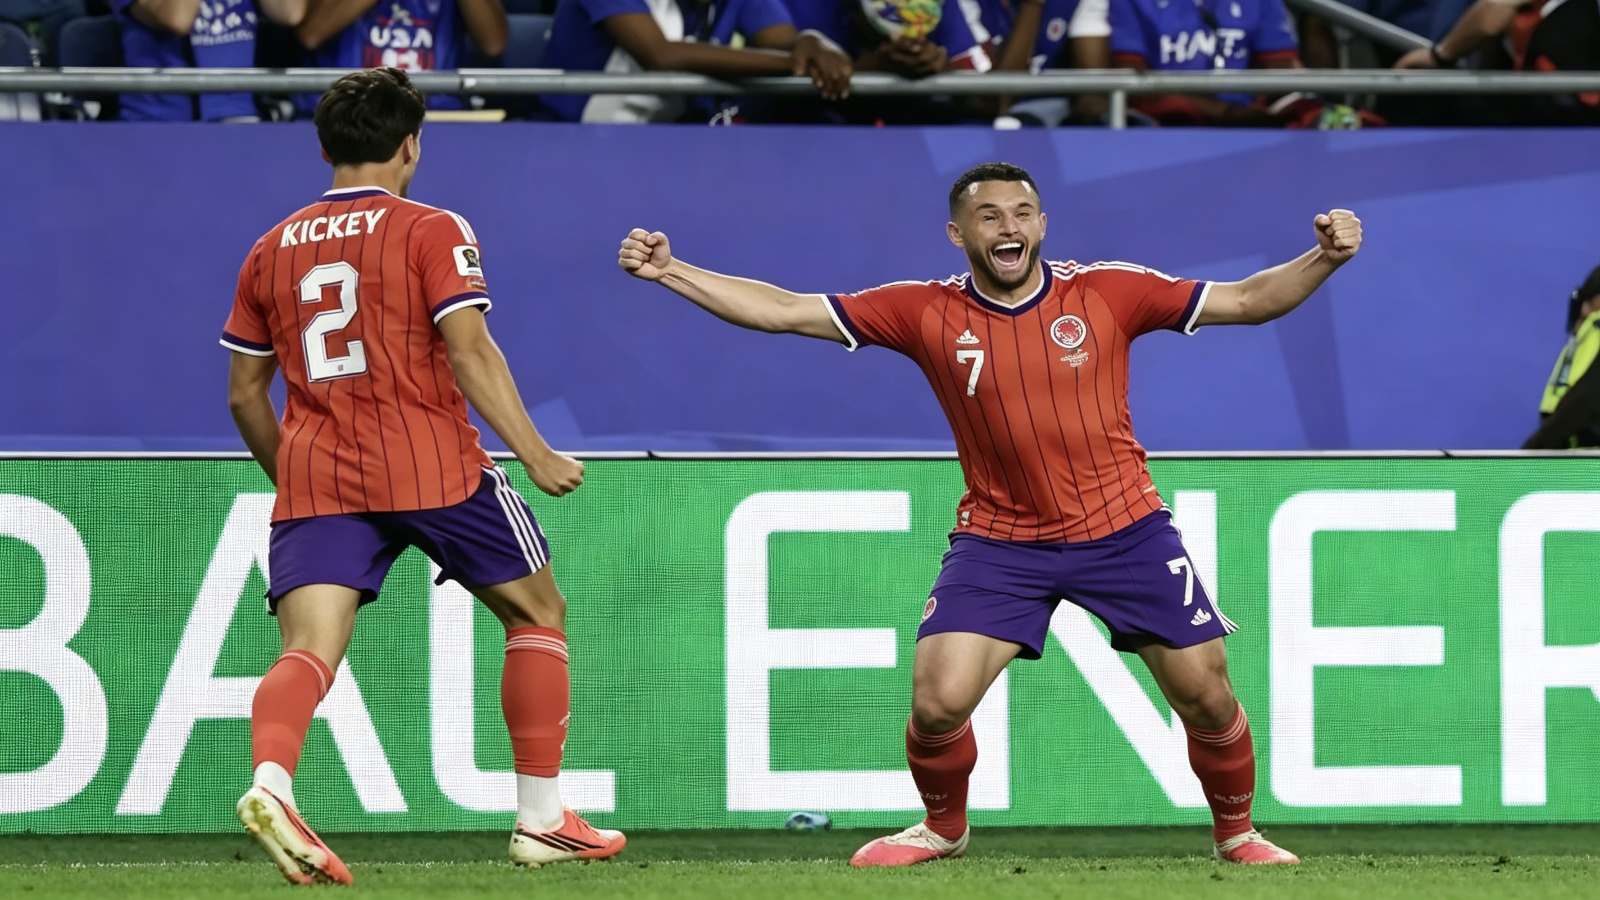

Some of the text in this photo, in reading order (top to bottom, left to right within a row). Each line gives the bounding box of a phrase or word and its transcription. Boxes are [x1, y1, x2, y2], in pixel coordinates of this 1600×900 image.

[280, 208, 387, 248] KICKEY
[299, 261, 368, 382] 2
[956, 350, 984, 397] 7
[1166, 556, 1193, 607] 7
